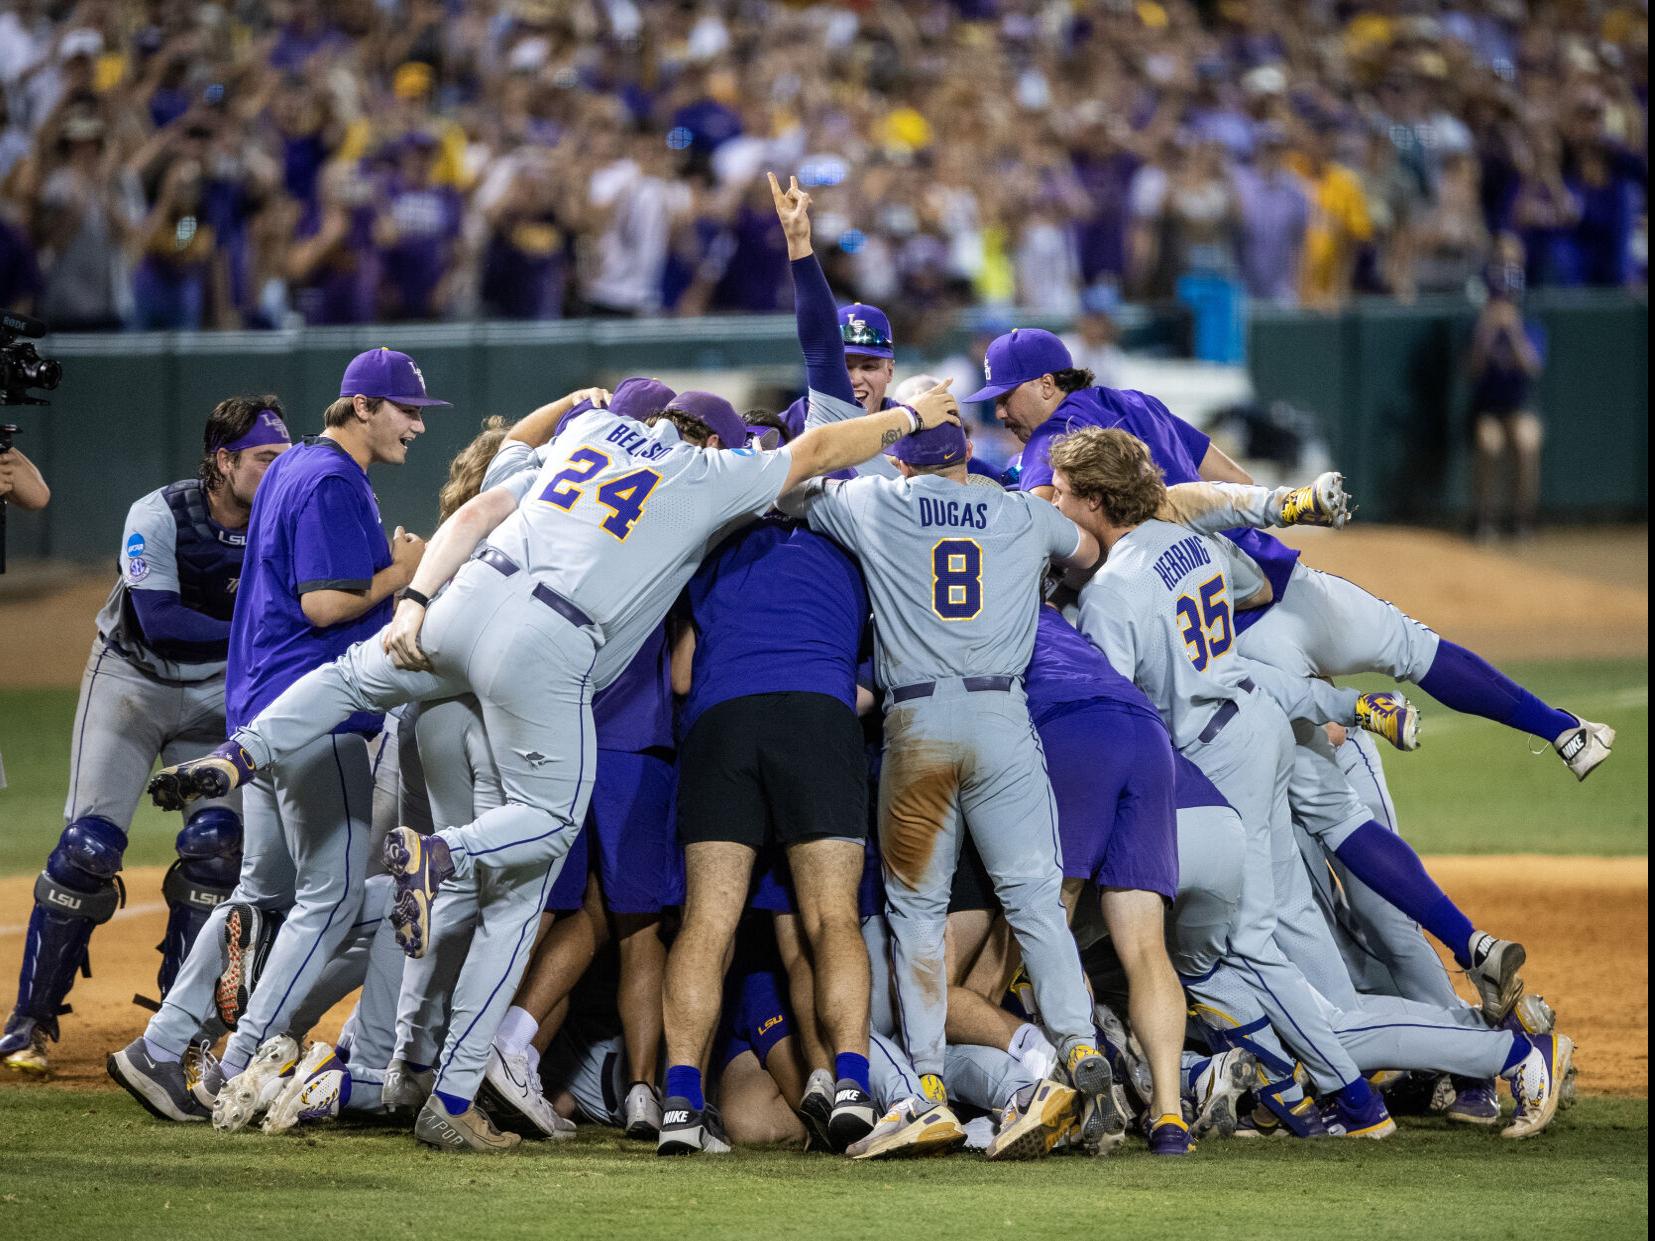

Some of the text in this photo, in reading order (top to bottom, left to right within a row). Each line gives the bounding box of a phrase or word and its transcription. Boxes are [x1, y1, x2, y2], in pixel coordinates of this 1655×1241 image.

[537, 444, 664, 545] 24
[918, 496, 988, 530] DUGAS
[1152, 535, 1212, 592] HERRING
[931, 537, 983, 621] 8
[1175, 571, 1233, 673] 35
[1561, 733, 1584, 761] NIKE
[48, 888, 82, 909] LSU
[189, 889, 226, 906] LSU
[757, 1013, 784, 1036] LSU
[834, 1088, 860, 1102] NIKE
[663, 1109, 689, 1125] NIKE
